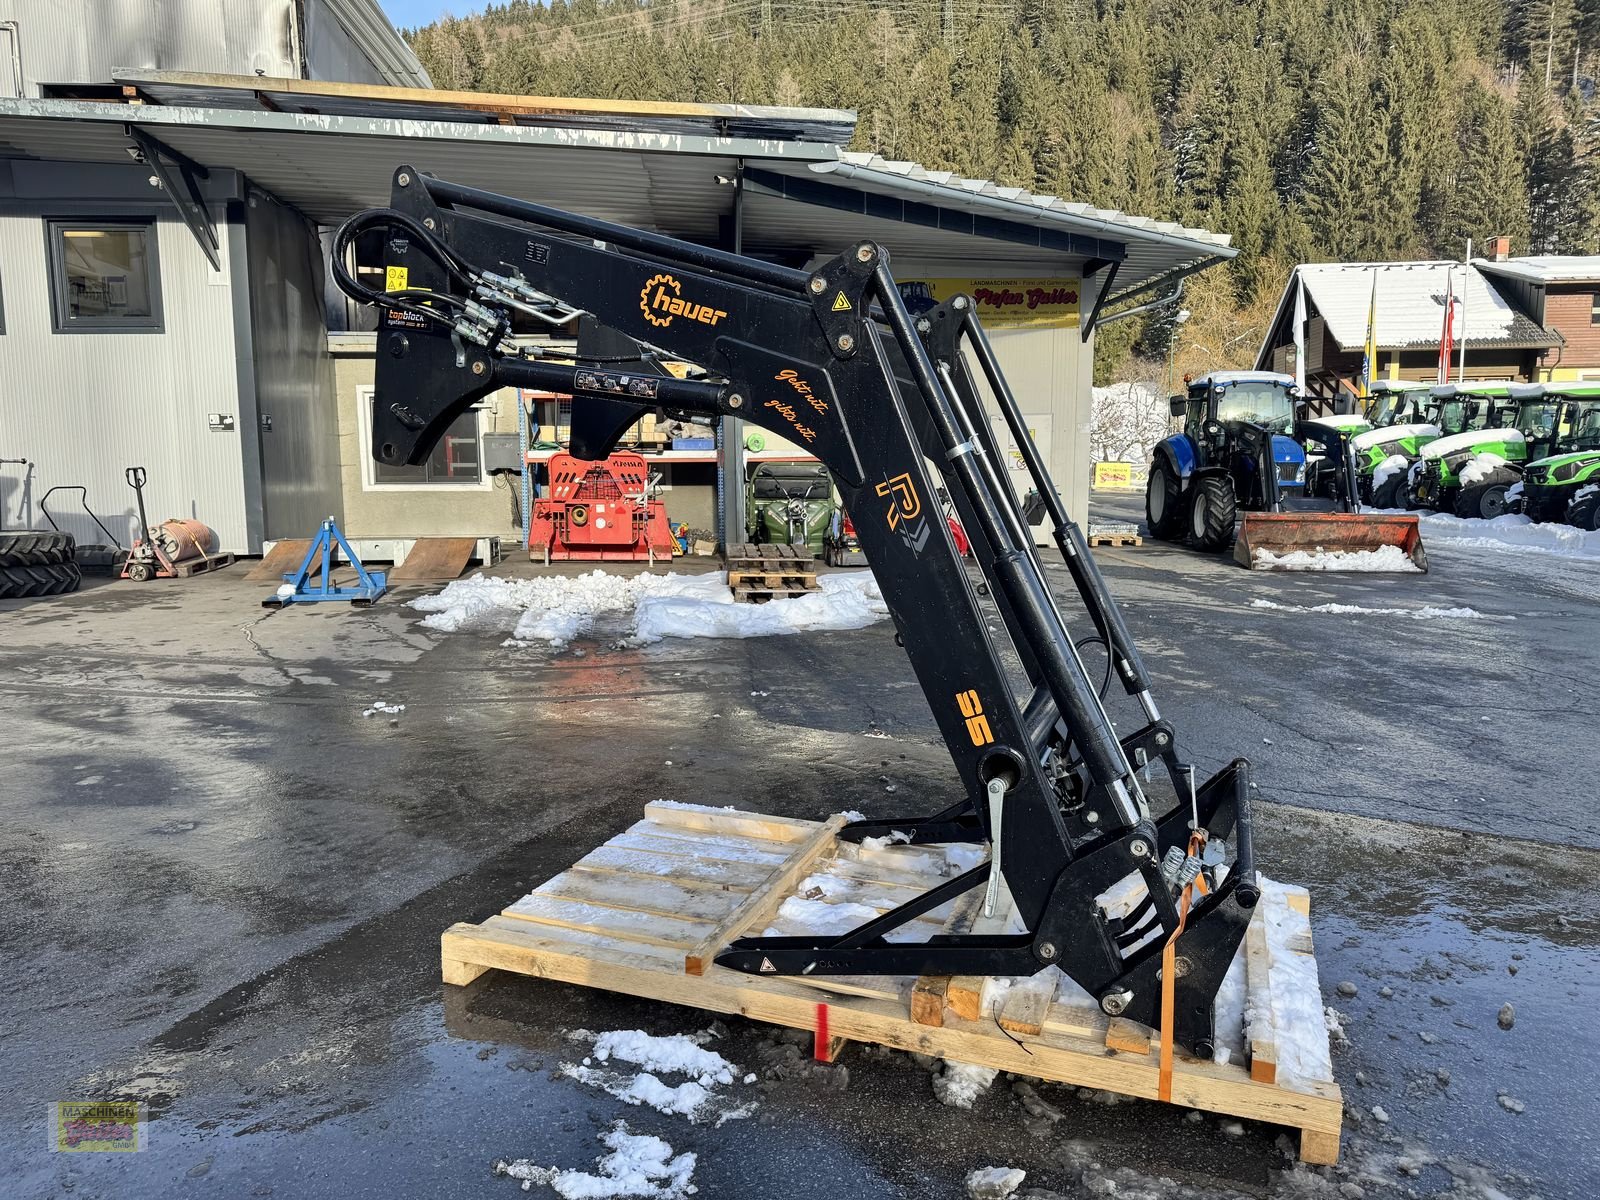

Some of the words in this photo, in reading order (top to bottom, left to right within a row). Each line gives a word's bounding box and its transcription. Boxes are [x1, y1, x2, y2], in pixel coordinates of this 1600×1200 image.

[388, 309, 424, 322] topblock
[653, 286, 727, 326] hauer
[774, 369, 812, 394] Geht
[764, 400, 796, 422] gibts
[955, 689, 995, 747] S5
